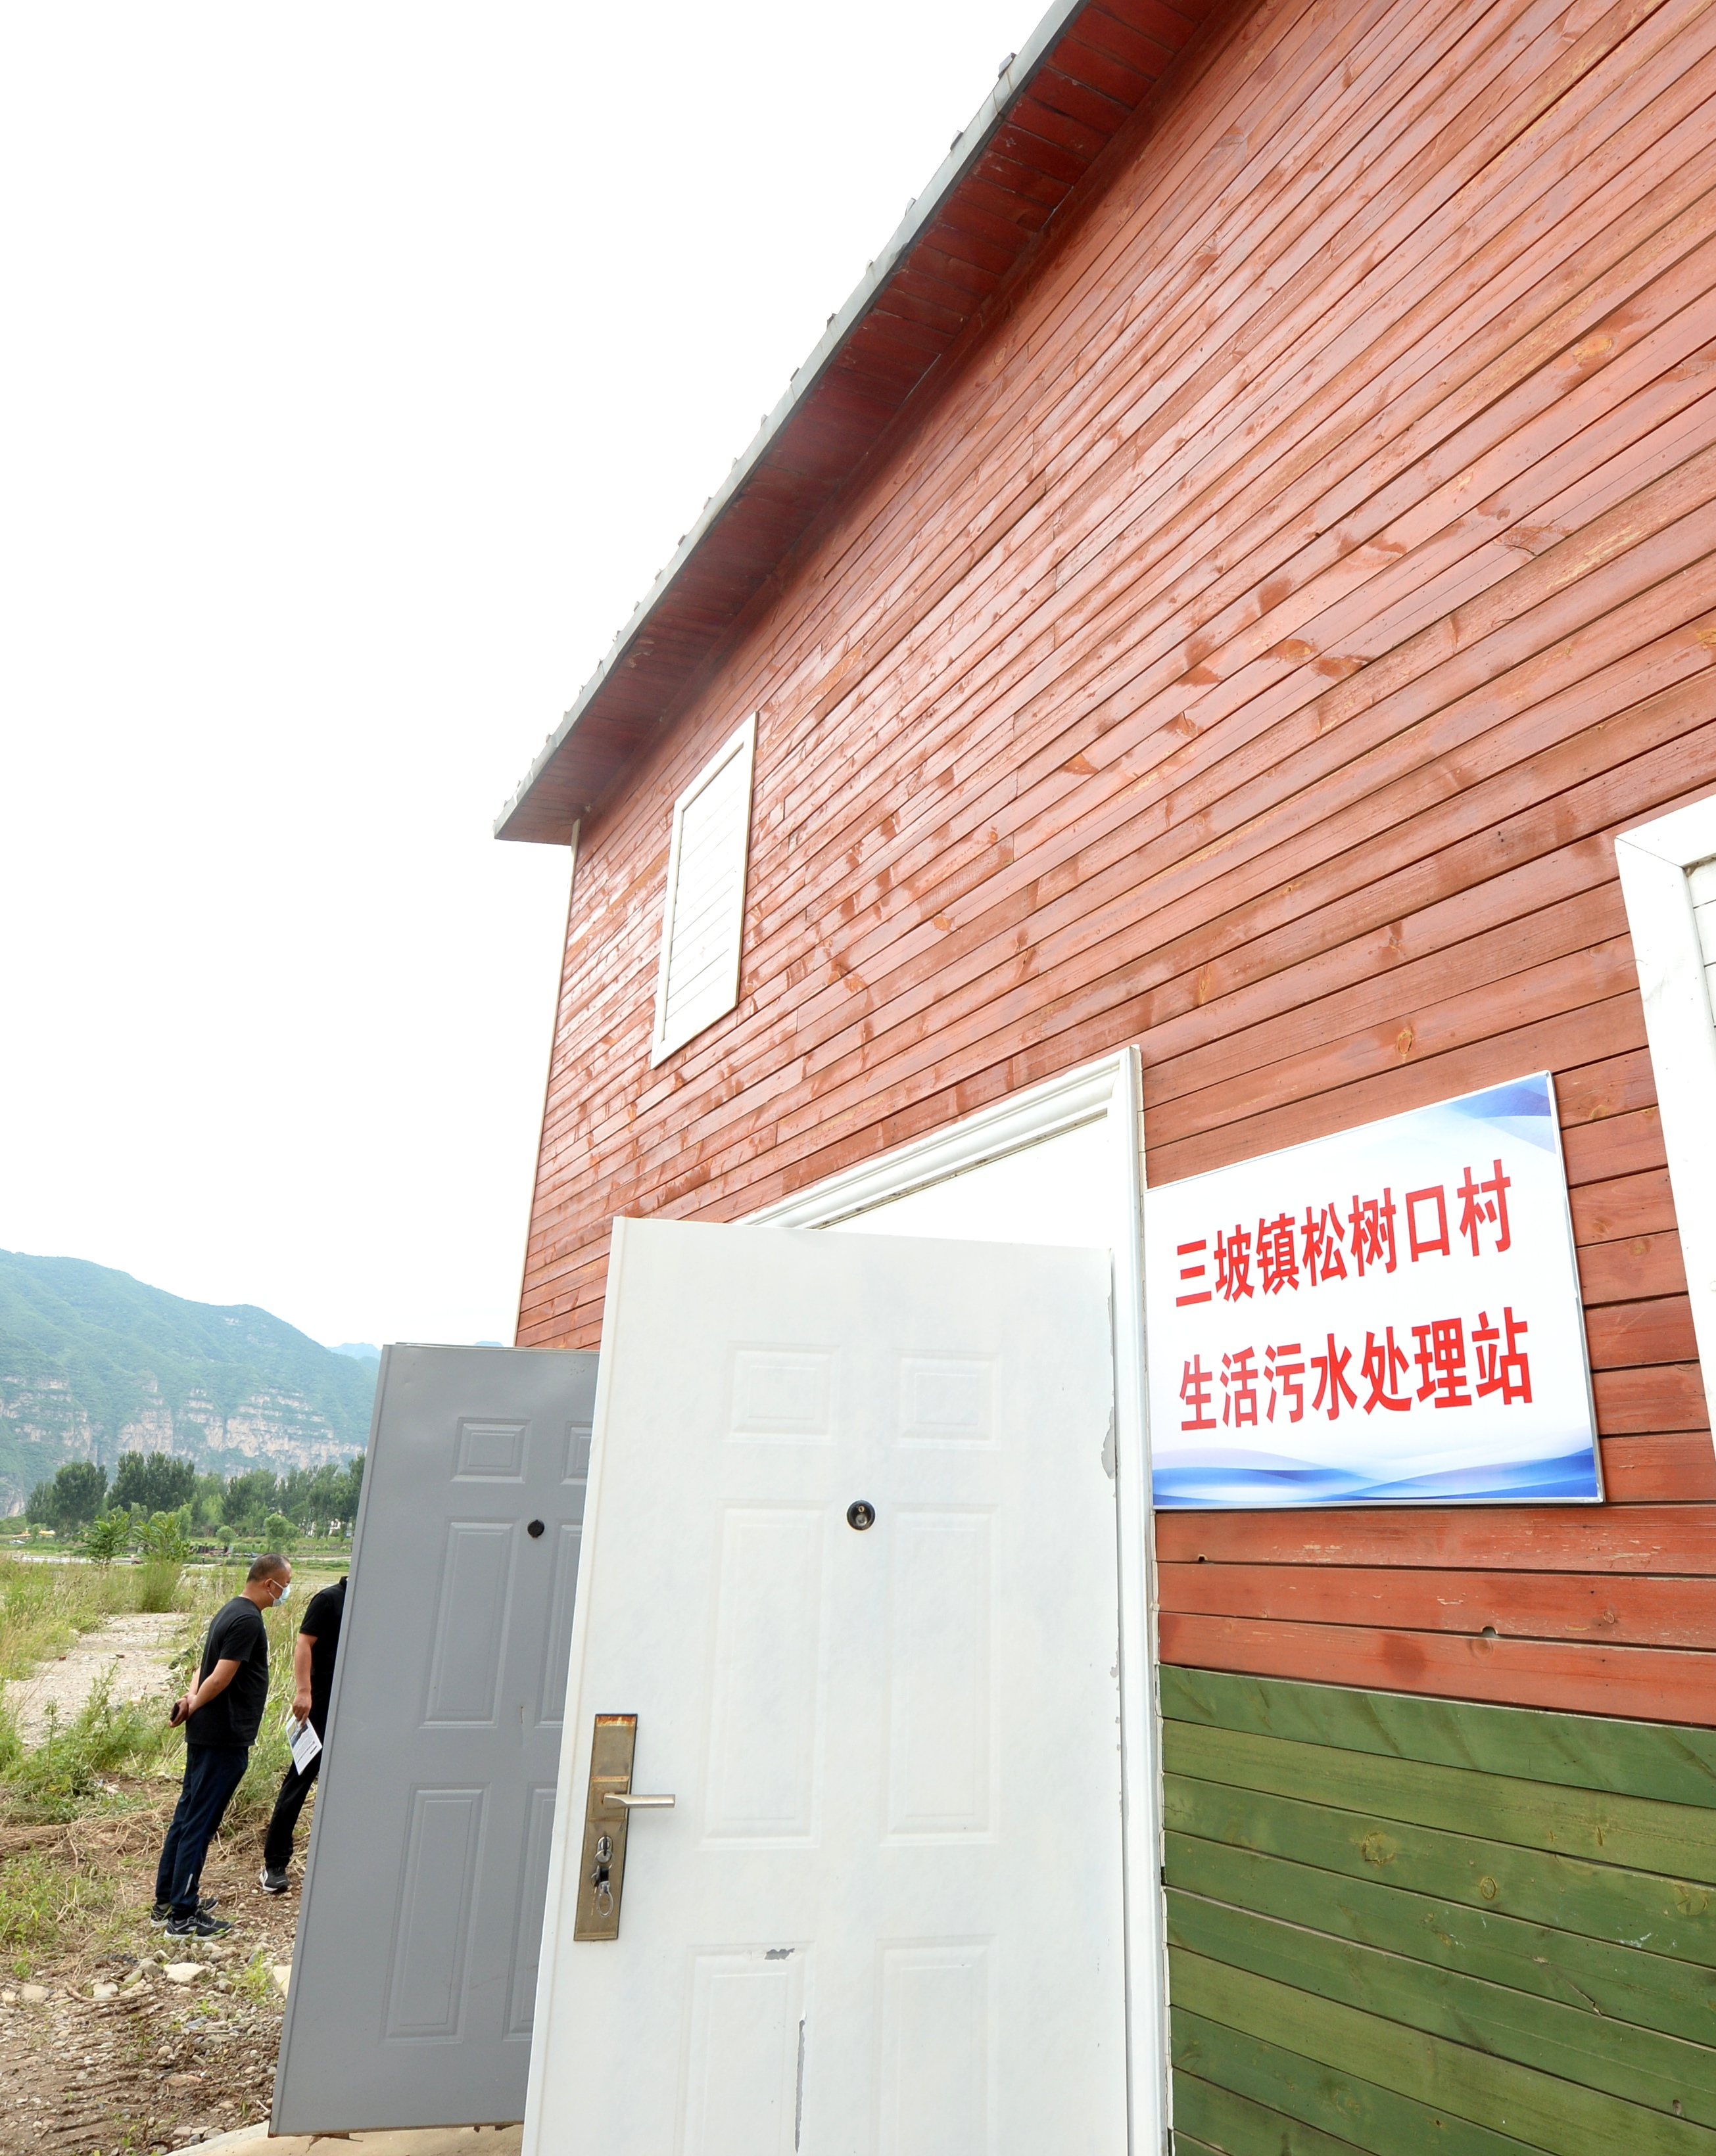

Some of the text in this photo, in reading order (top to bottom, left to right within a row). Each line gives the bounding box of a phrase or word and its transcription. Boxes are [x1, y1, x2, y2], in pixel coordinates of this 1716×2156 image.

[1176, 1159, 1512, 1307] 三坡镇松树口村
[1179, 1306, 1533, 1431] 生活污水处理站
